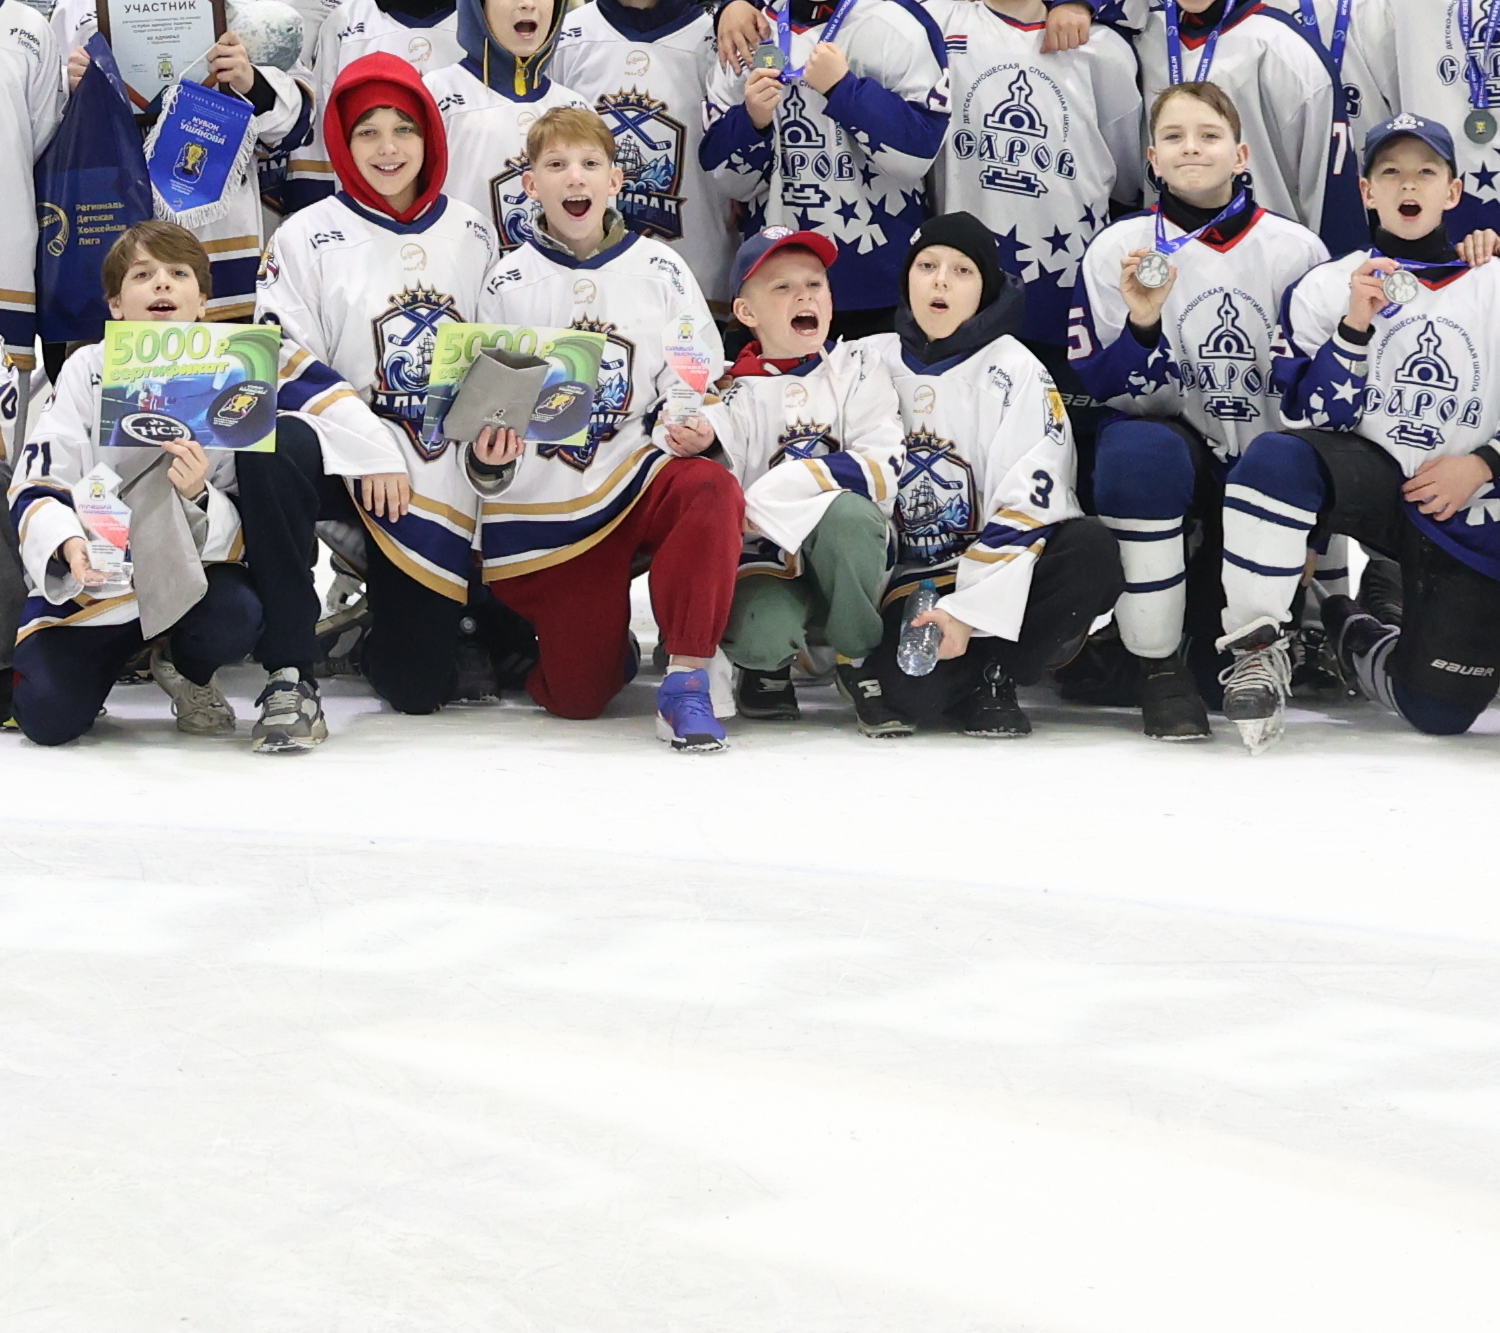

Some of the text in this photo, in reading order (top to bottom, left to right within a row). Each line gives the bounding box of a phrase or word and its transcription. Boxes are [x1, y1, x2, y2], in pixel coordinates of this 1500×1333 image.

[125, 0, 197, 13] УЧАСТНИК
[963, 63, 1020, 124] ДЕТСКО-ЮНОШЕСКАЯ
[1029, 66, 1068, 111] СПОРТИВНАЯ
[953, 129, 1077, 180] САРОВ
[76, 213, 114, 224] Детская
[78, 237, 100, 246] Лига
[112, 325, 212, 365] 5000
[1436, 316, 1478, 359] СПОРТИВНАЯ
[1471, 361, 1480, 392] ШКОЛА
[110, 361, 230, 383] сертификат
[1362, 384, 1483, 429] САРОВ
[1032, 470, 1053, 509] 3
[1431, 657, 1495, 678] BAUER
